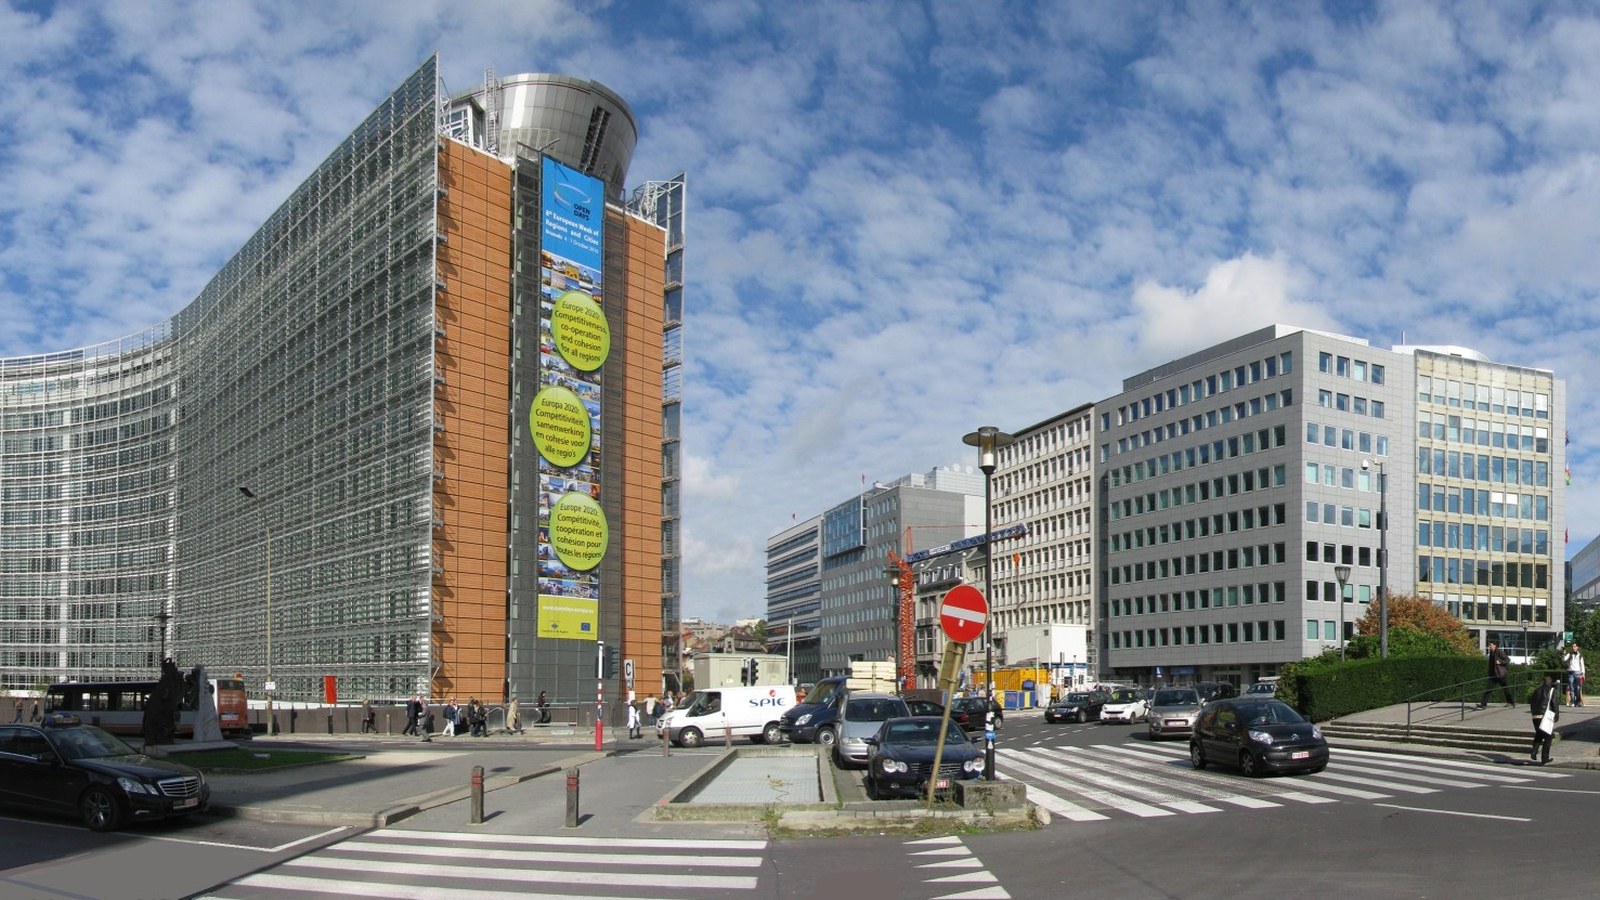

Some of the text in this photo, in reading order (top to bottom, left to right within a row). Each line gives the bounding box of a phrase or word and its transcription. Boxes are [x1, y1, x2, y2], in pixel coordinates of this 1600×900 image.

[574, 204, 591, 215] OPEN
[574, 211, 590, 221] DAYS
[553, 212, 578, 228] European
[579, 223, 592, 234] Week
[546, 218, 598, 246] Regions and Cities
[562, 300, 601, 321] Europe 2020:
[560, 324, 602, 342] co-operation
[560, 333, 602, 352] and cohesion
[560, 342, 570, 353] for
[579, 351, 601, 362] regions
[541, 398, 580, 415] Europa 2020:
[535, 409, 585, 428] Competitiviteit,
[536, 421, 584, 438] samenwerking
[536, 432, 585, 448] en cohesie voor
[544, 445, 576, 459] alle regio's
[560, 503, 599, 516] Europe 2020:
[557, 515, 602, 528] Compétitivité,
[556, 525, 594, 538] coopération
[557, 536, 601, 549] cohésion pour
[556, 545, 574, 556] toutes
[582, 550, 602, 560] régions
[625, 662, 631, 676] C
